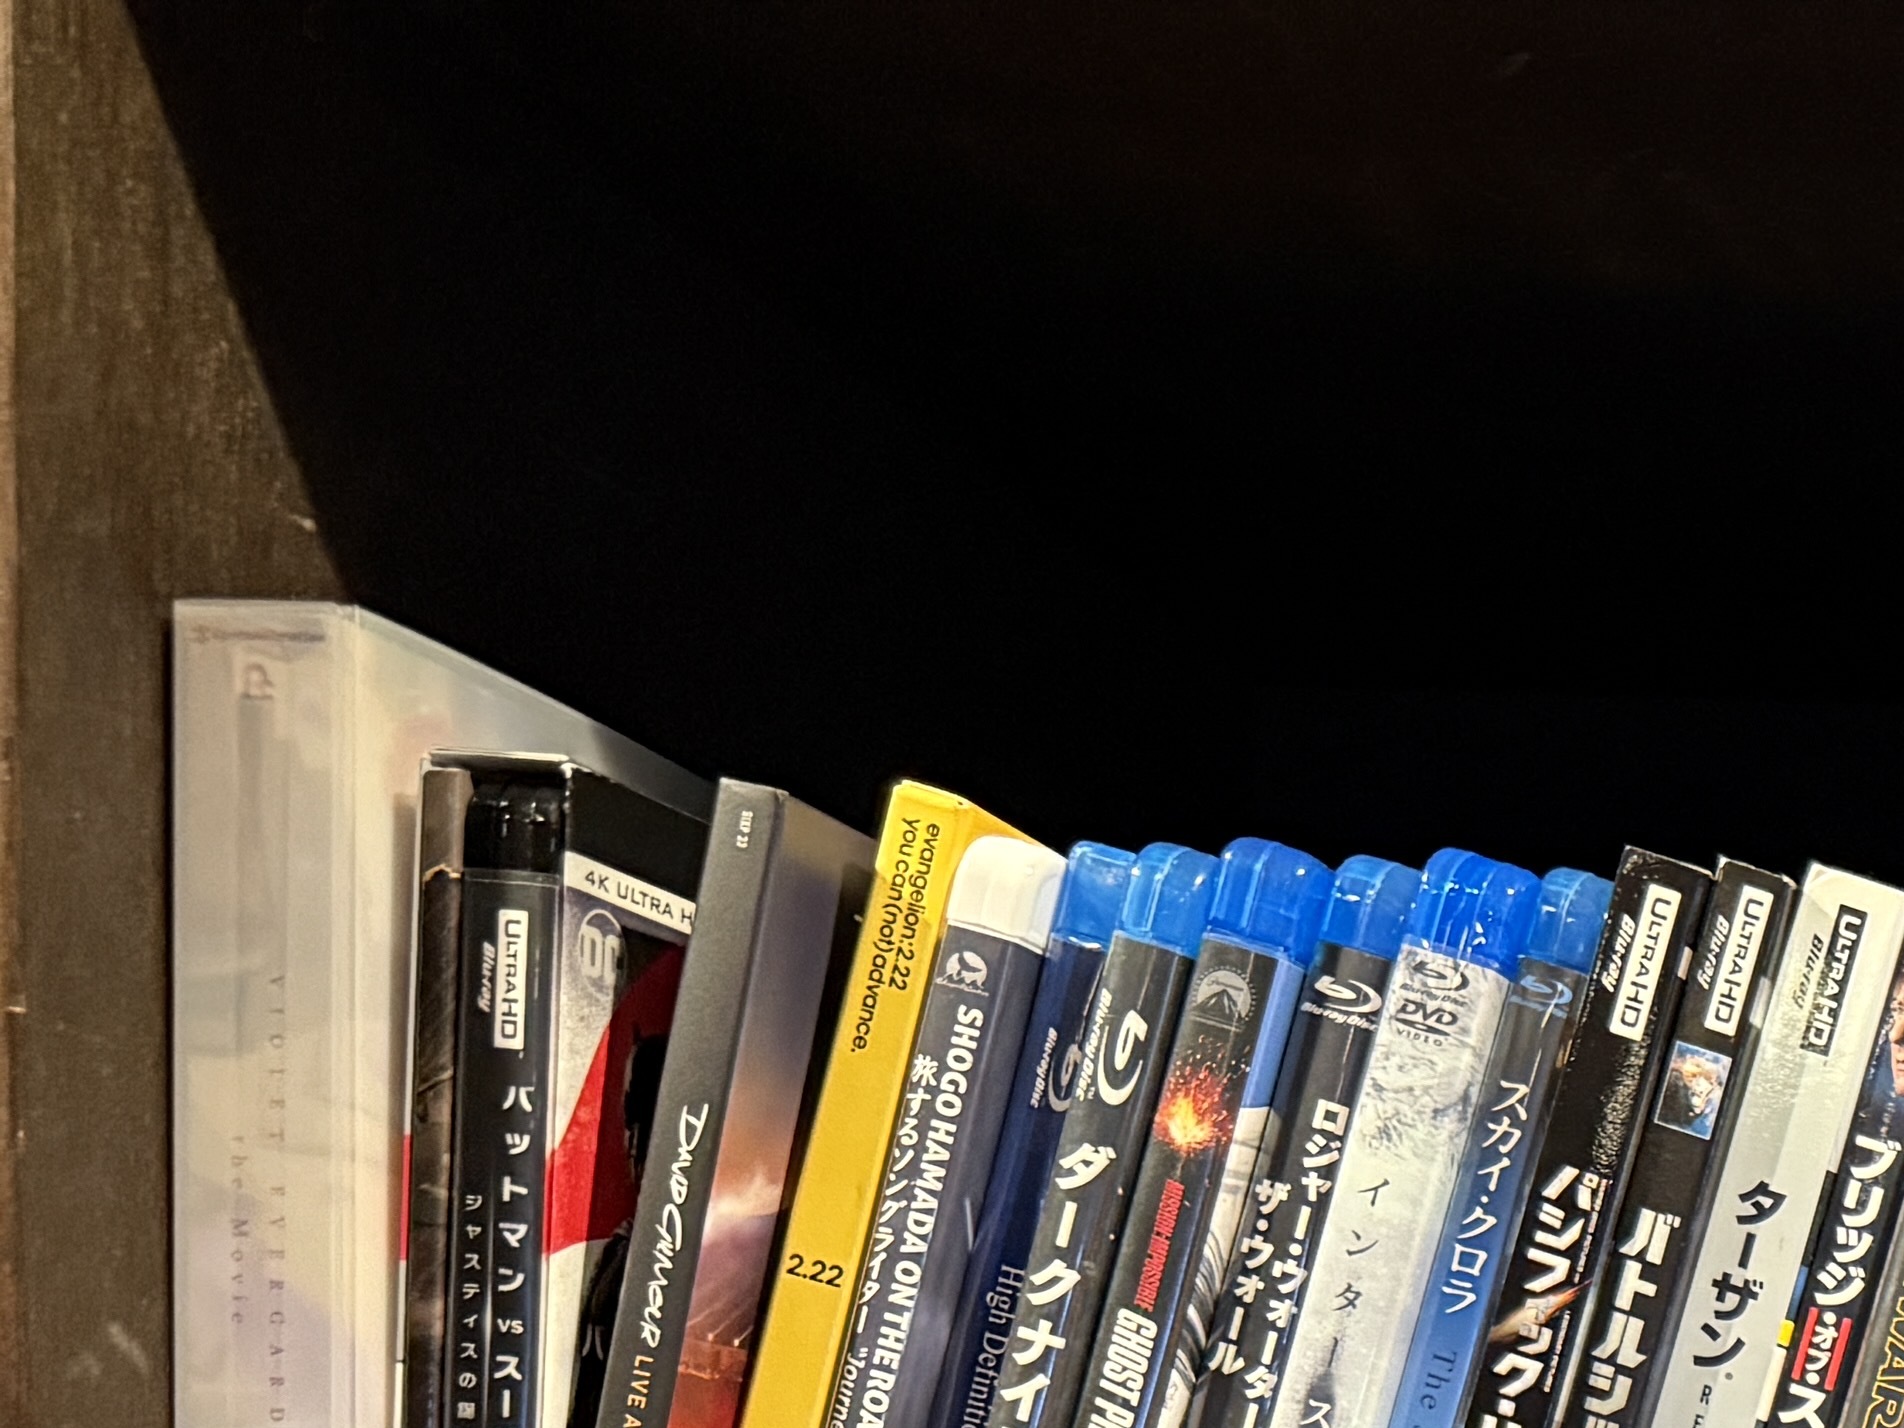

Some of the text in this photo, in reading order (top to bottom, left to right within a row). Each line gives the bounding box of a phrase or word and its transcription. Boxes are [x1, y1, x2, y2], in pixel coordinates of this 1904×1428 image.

[585, 868, 676, 920] 4K ULTRA
[495, 1085, 536, 1293] バットマン
[1440, 1080, 1528, 1315] スカイ・クロラ
[787, 1255, 843, 1288] 2.22
[1206, 1180, 1294, 1375] ザ・ウォール
[627, 1356, 653, 1405] LIVE
[1099, 1307, 1158, 1403] GHOST
